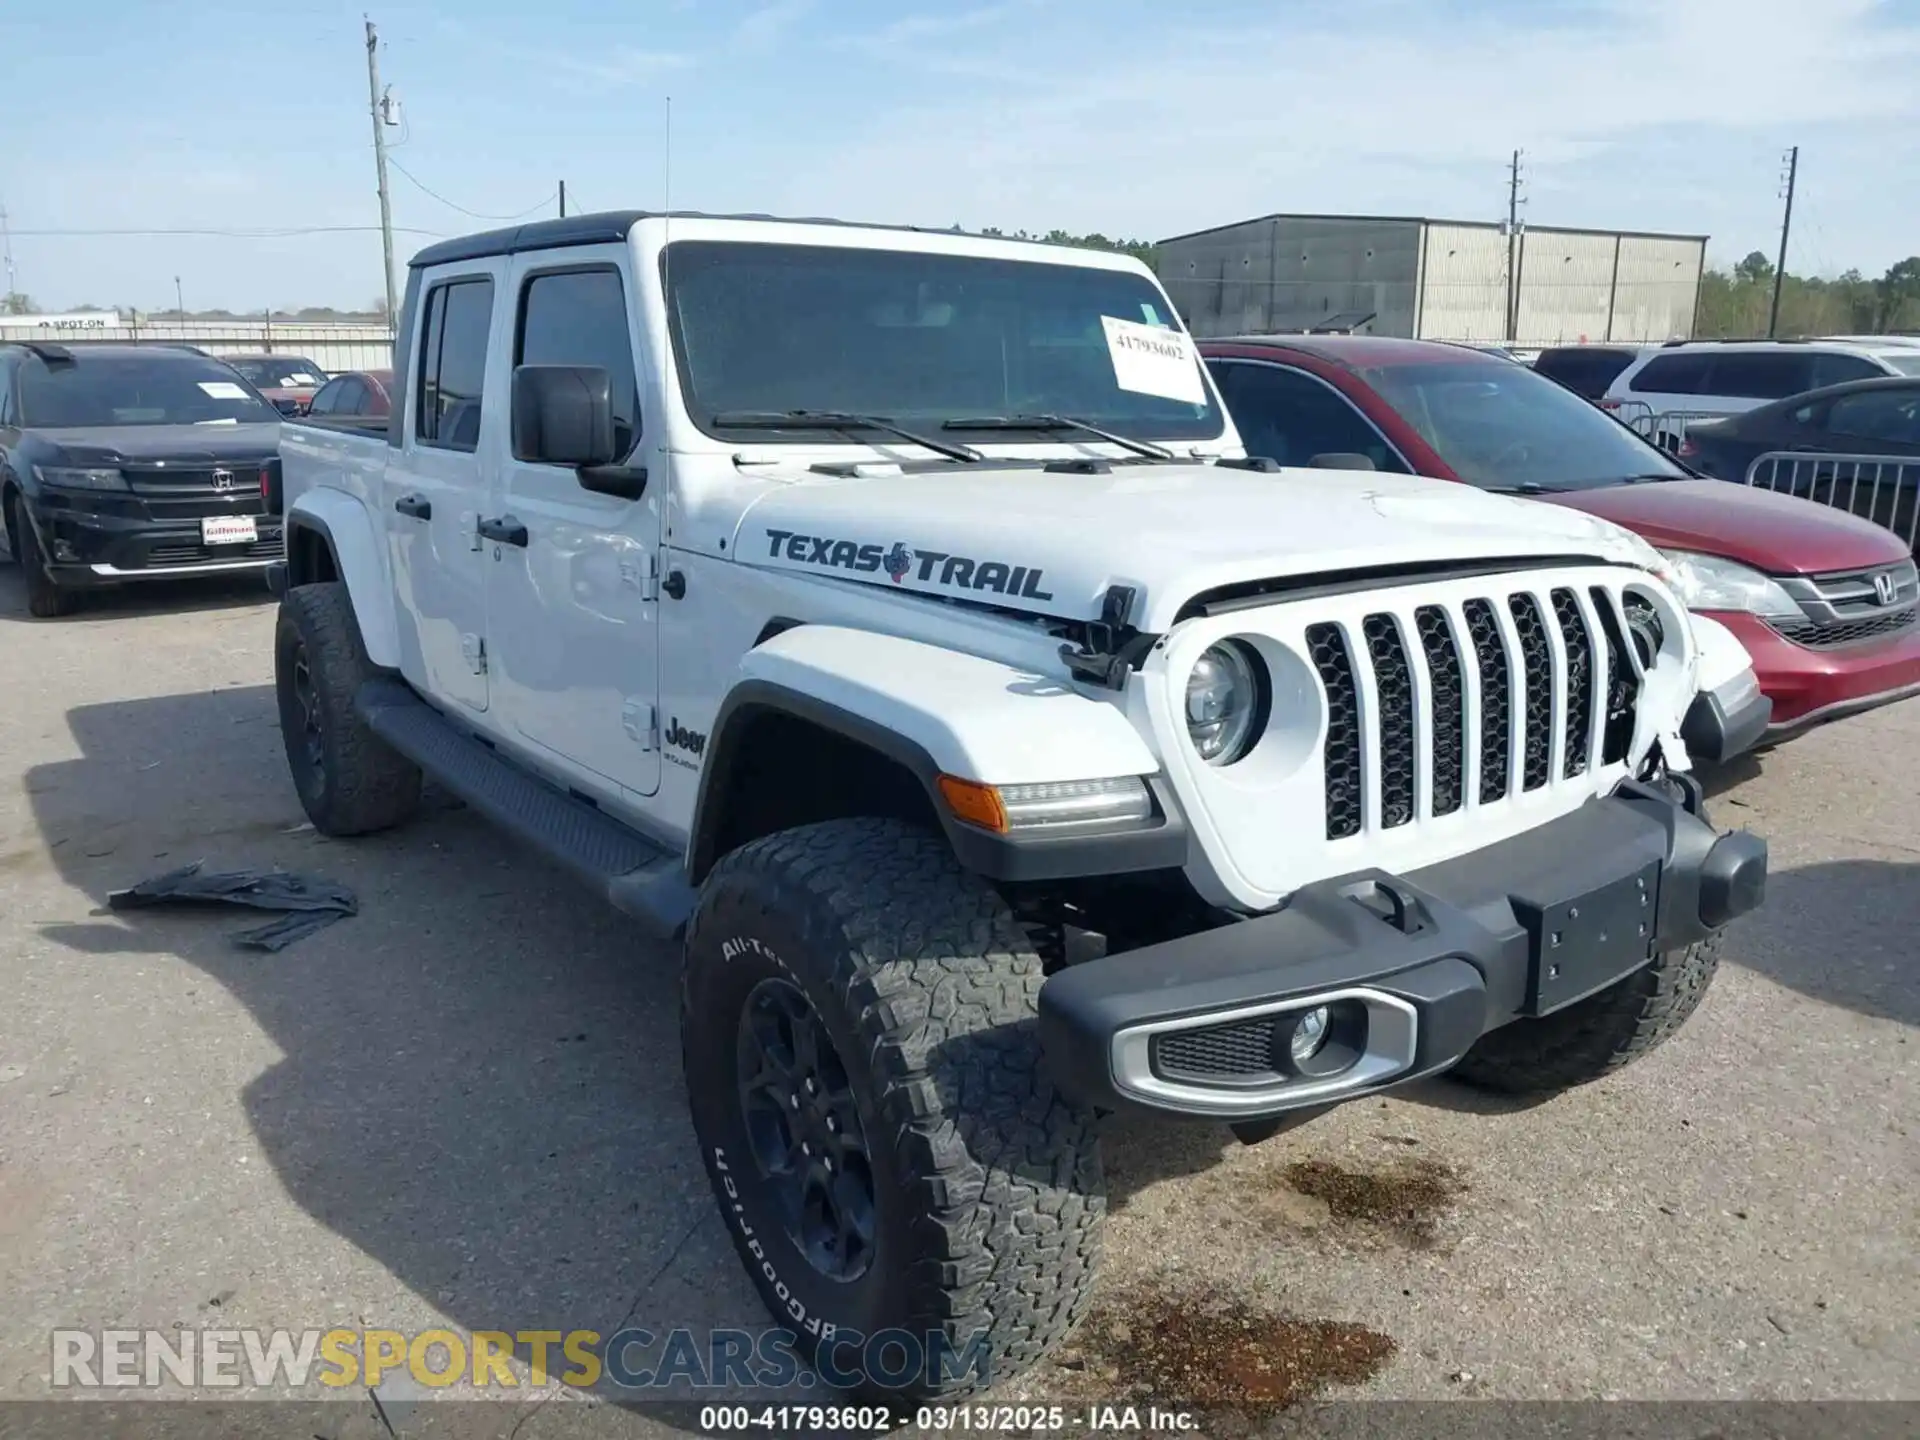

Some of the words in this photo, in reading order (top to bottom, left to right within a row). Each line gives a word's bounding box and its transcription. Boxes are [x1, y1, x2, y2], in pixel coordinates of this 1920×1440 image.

[1116, 334, 1184, 360] 41793602
[765, 528, 885, 573] TEXAS
[912, 549, 1054, 602] TRAIL
[664, 716, 707, 761] Jeep
